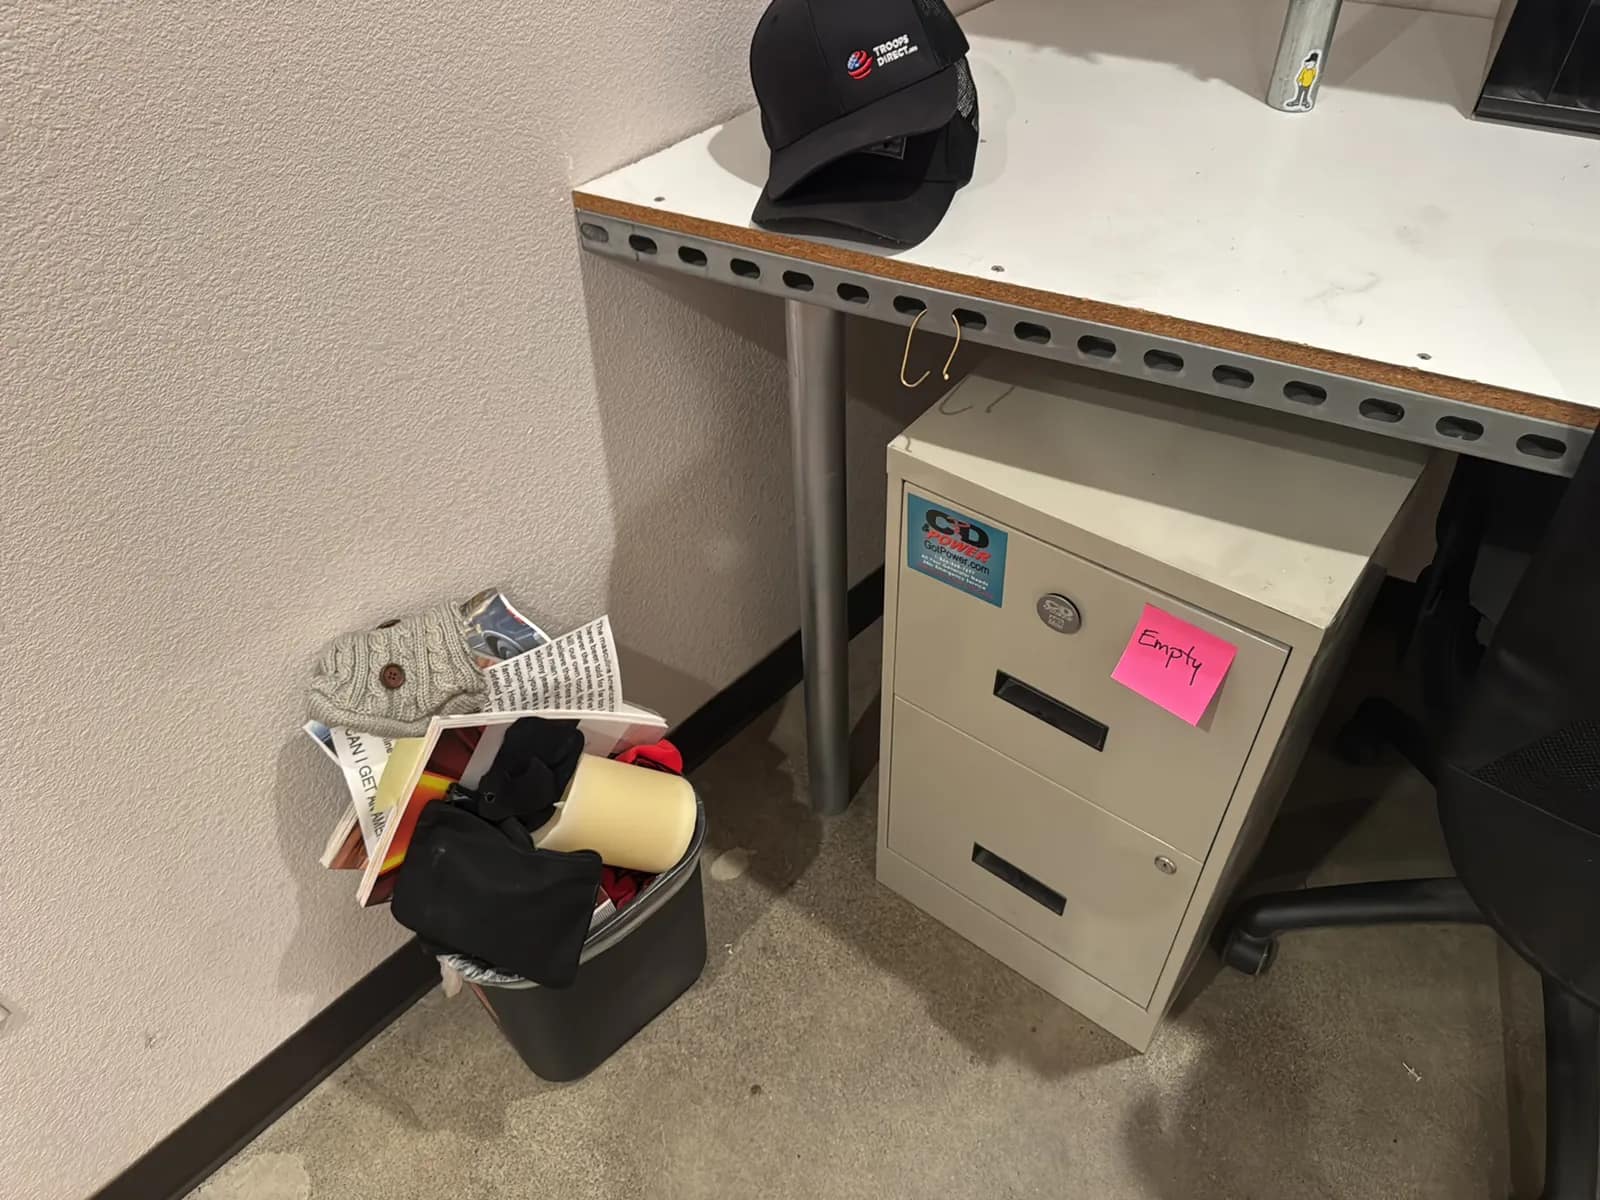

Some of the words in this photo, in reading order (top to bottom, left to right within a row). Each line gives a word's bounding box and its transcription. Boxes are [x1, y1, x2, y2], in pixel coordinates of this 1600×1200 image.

[872, 34, 909, 57] TROOPS
[924, 540, 990, 576] GotPower.com
[927, 530, 992, 564] POWER
[535, 650, 545, 673] skinny
[555, 639, 567, 667] believe
[562, 666, 571, 683] that
[566, 634, 575, 647] kill
[572, 661, 580, 678] own
[576, 631, 585, 652] never
[581, 651, 589, 665] the
[586, 625, 594, 644] have
[591, 644, 599, 664] been
[595, 664, 604, 679] told
[596, 620, 604, 636] The
[600, 637, 611, 674] masculine
[1138, 629, 1202, 686] Empty
[489, 668, 503, 696] defend
[501, 664, 512, 690] family.
[508, 690, 516, 707] How
[513, 659, 528, 702] responsible
[549, 658, 558, 676] man
[553, 676, 561, 691] who
[359, 765, 377, 792] GET
[371, 811, 385, 838] AME
